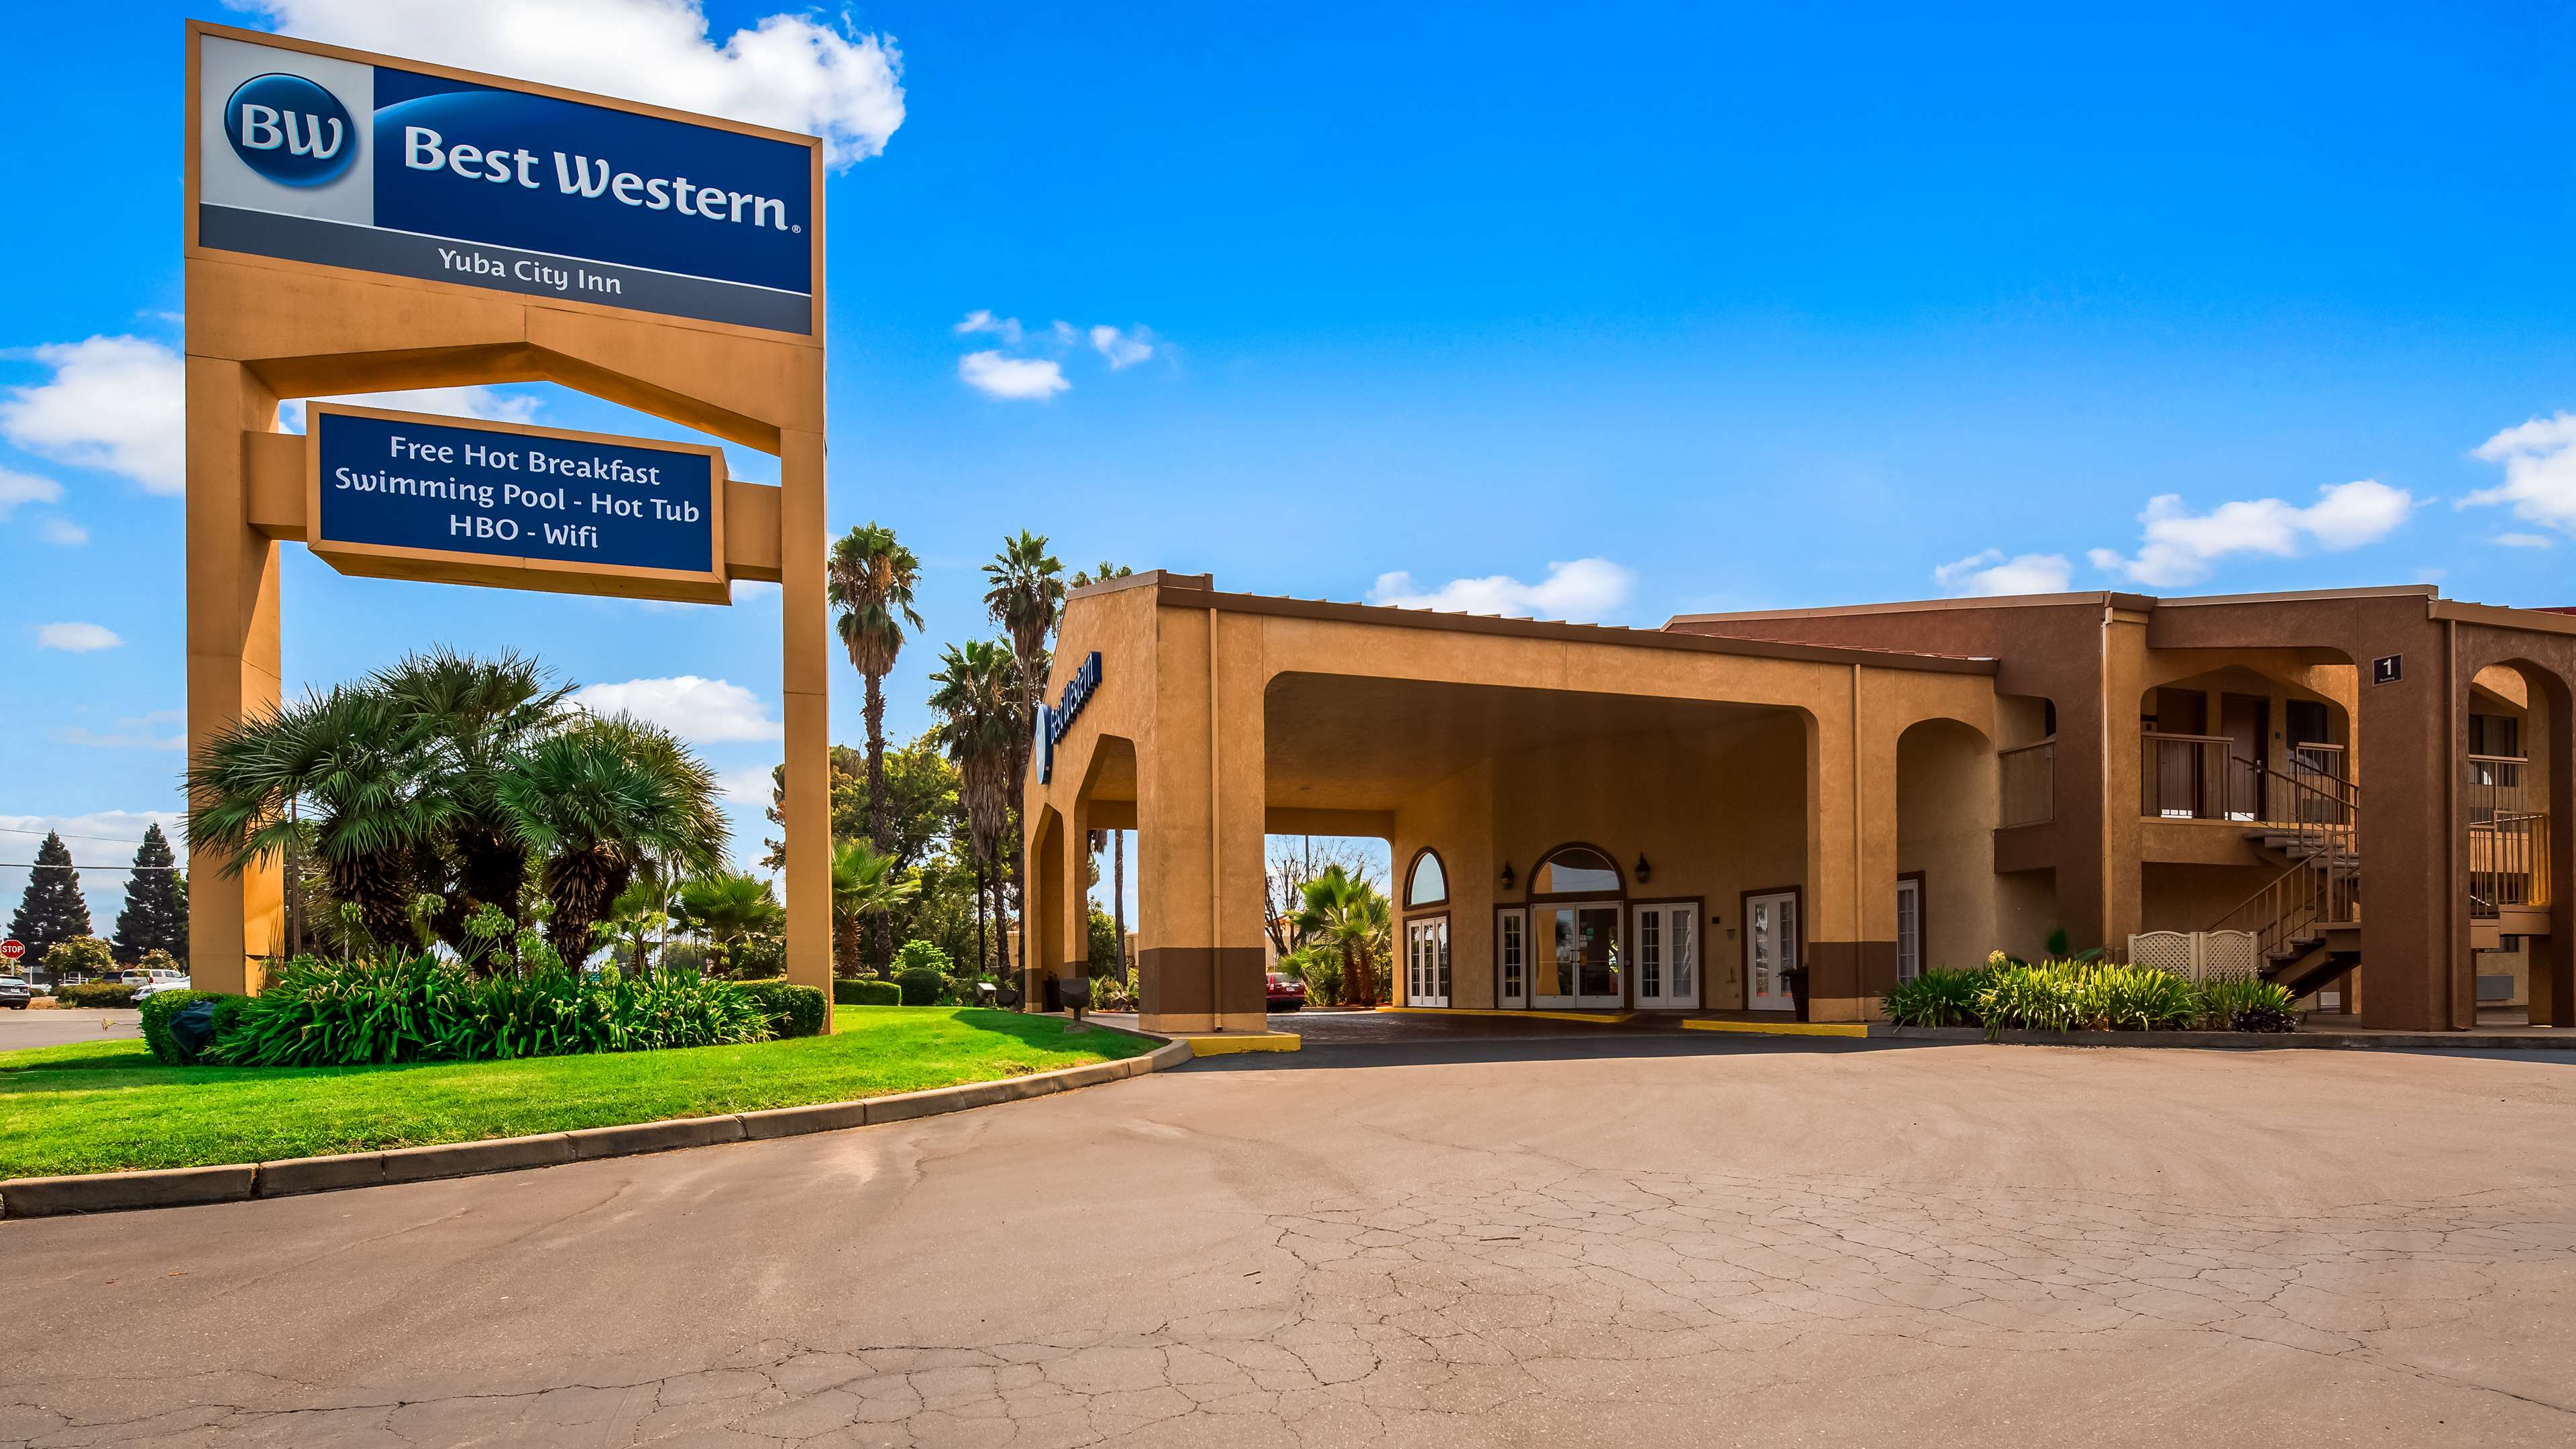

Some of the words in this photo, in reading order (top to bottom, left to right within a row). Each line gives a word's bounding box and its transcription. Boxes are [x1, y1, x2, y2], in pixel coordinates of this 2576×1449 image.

[241, 103, 343, 159] BW
[405, 125, 541, 189] Best
[437, 248, 507, 278] Yuba
[513, 260, 569, 291] City
[578, 268, 623, 295] Inn
[390, 435, 454, 464] Free
[464, 444, 520, 471] Hot
[529, 450, 661, 486] Breakfast
[335, 467, 495, 508] Swimming
[504, 483, 566, 511] Pool
[591, 492, 644, 519] Hot
[650, 498, 700, 523] Tub
[450, 514, 519, 541] HBO
[543, 522, 599, 549] Wifi
[2383, 658, 2392, 676] 1
[2, 945, 23, 953] STOP
